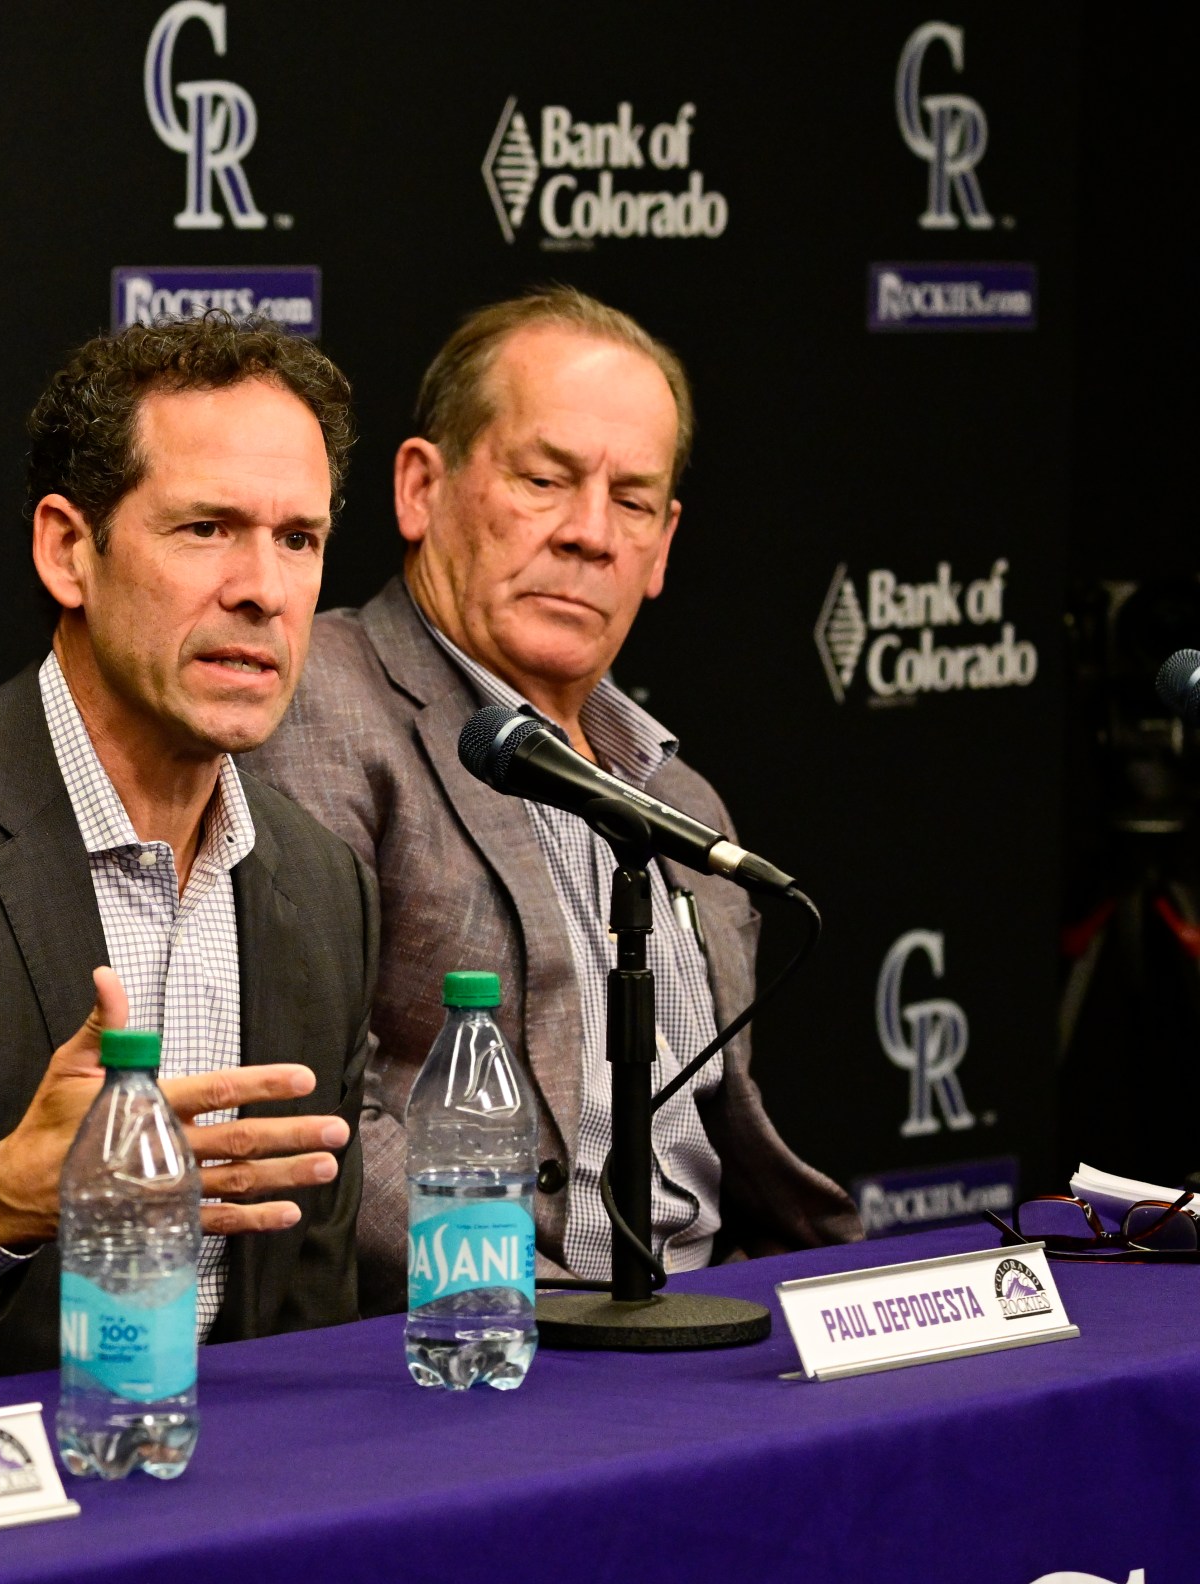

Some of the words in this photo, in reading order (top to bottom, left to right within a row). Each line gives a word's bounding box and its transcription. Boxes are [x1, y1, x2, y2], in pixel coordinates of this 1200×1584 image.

[541, 103, 644, 169] Bank
[649, 103, 695, 170] of
[539, 172, 728, 239] Colorado
[868, 561, 962, 629] Bank
[967, 559, 1009, 624] of
[867, 625, 1038, 696] Colorado
[821, 1304, 877, 1343] PAUL
[873, 1285, 985, 1333] DEPODESTA
[998, 1292, 1051, 1316] ROCKIES
